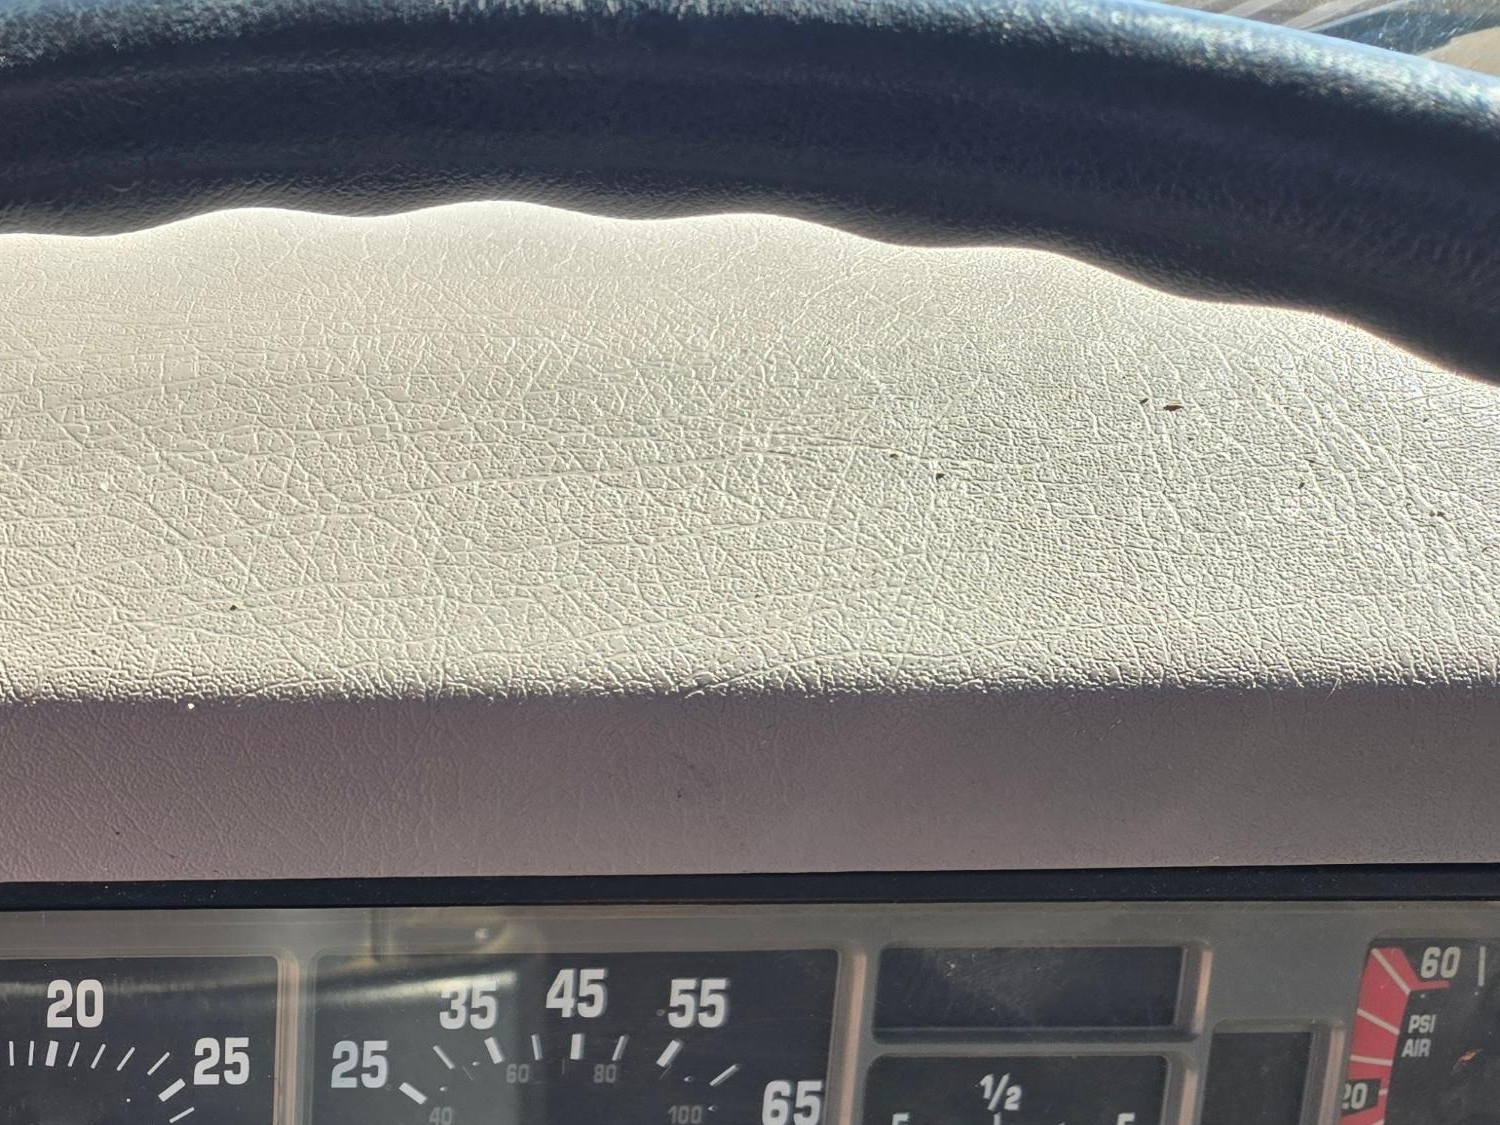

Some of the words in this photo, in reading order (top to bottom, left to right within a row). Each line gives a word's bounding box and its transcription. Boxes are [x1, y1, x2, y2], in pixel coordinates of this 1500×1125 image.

[1420, 946, 1461, 979] 60
[46, 979, 104, 1028] 20
[439, 982, 499, 1030] 35
[545, 968, 608, 1018] 45
[667, 978, 730, 1028] 55
[1408, 1014, 1437, 1034] PSI
[193, 1037, 250, 1085] 25
[1402, 1038, 1431, 1057] AIR
[330, 1040, 388, 1089] 25
[506, 1063, 530, 1083] 60
[593, 1063, 617, 1084] 80
[429, 1106, 453, 1125] 40
[668, 1105, 703, 1125] 100
